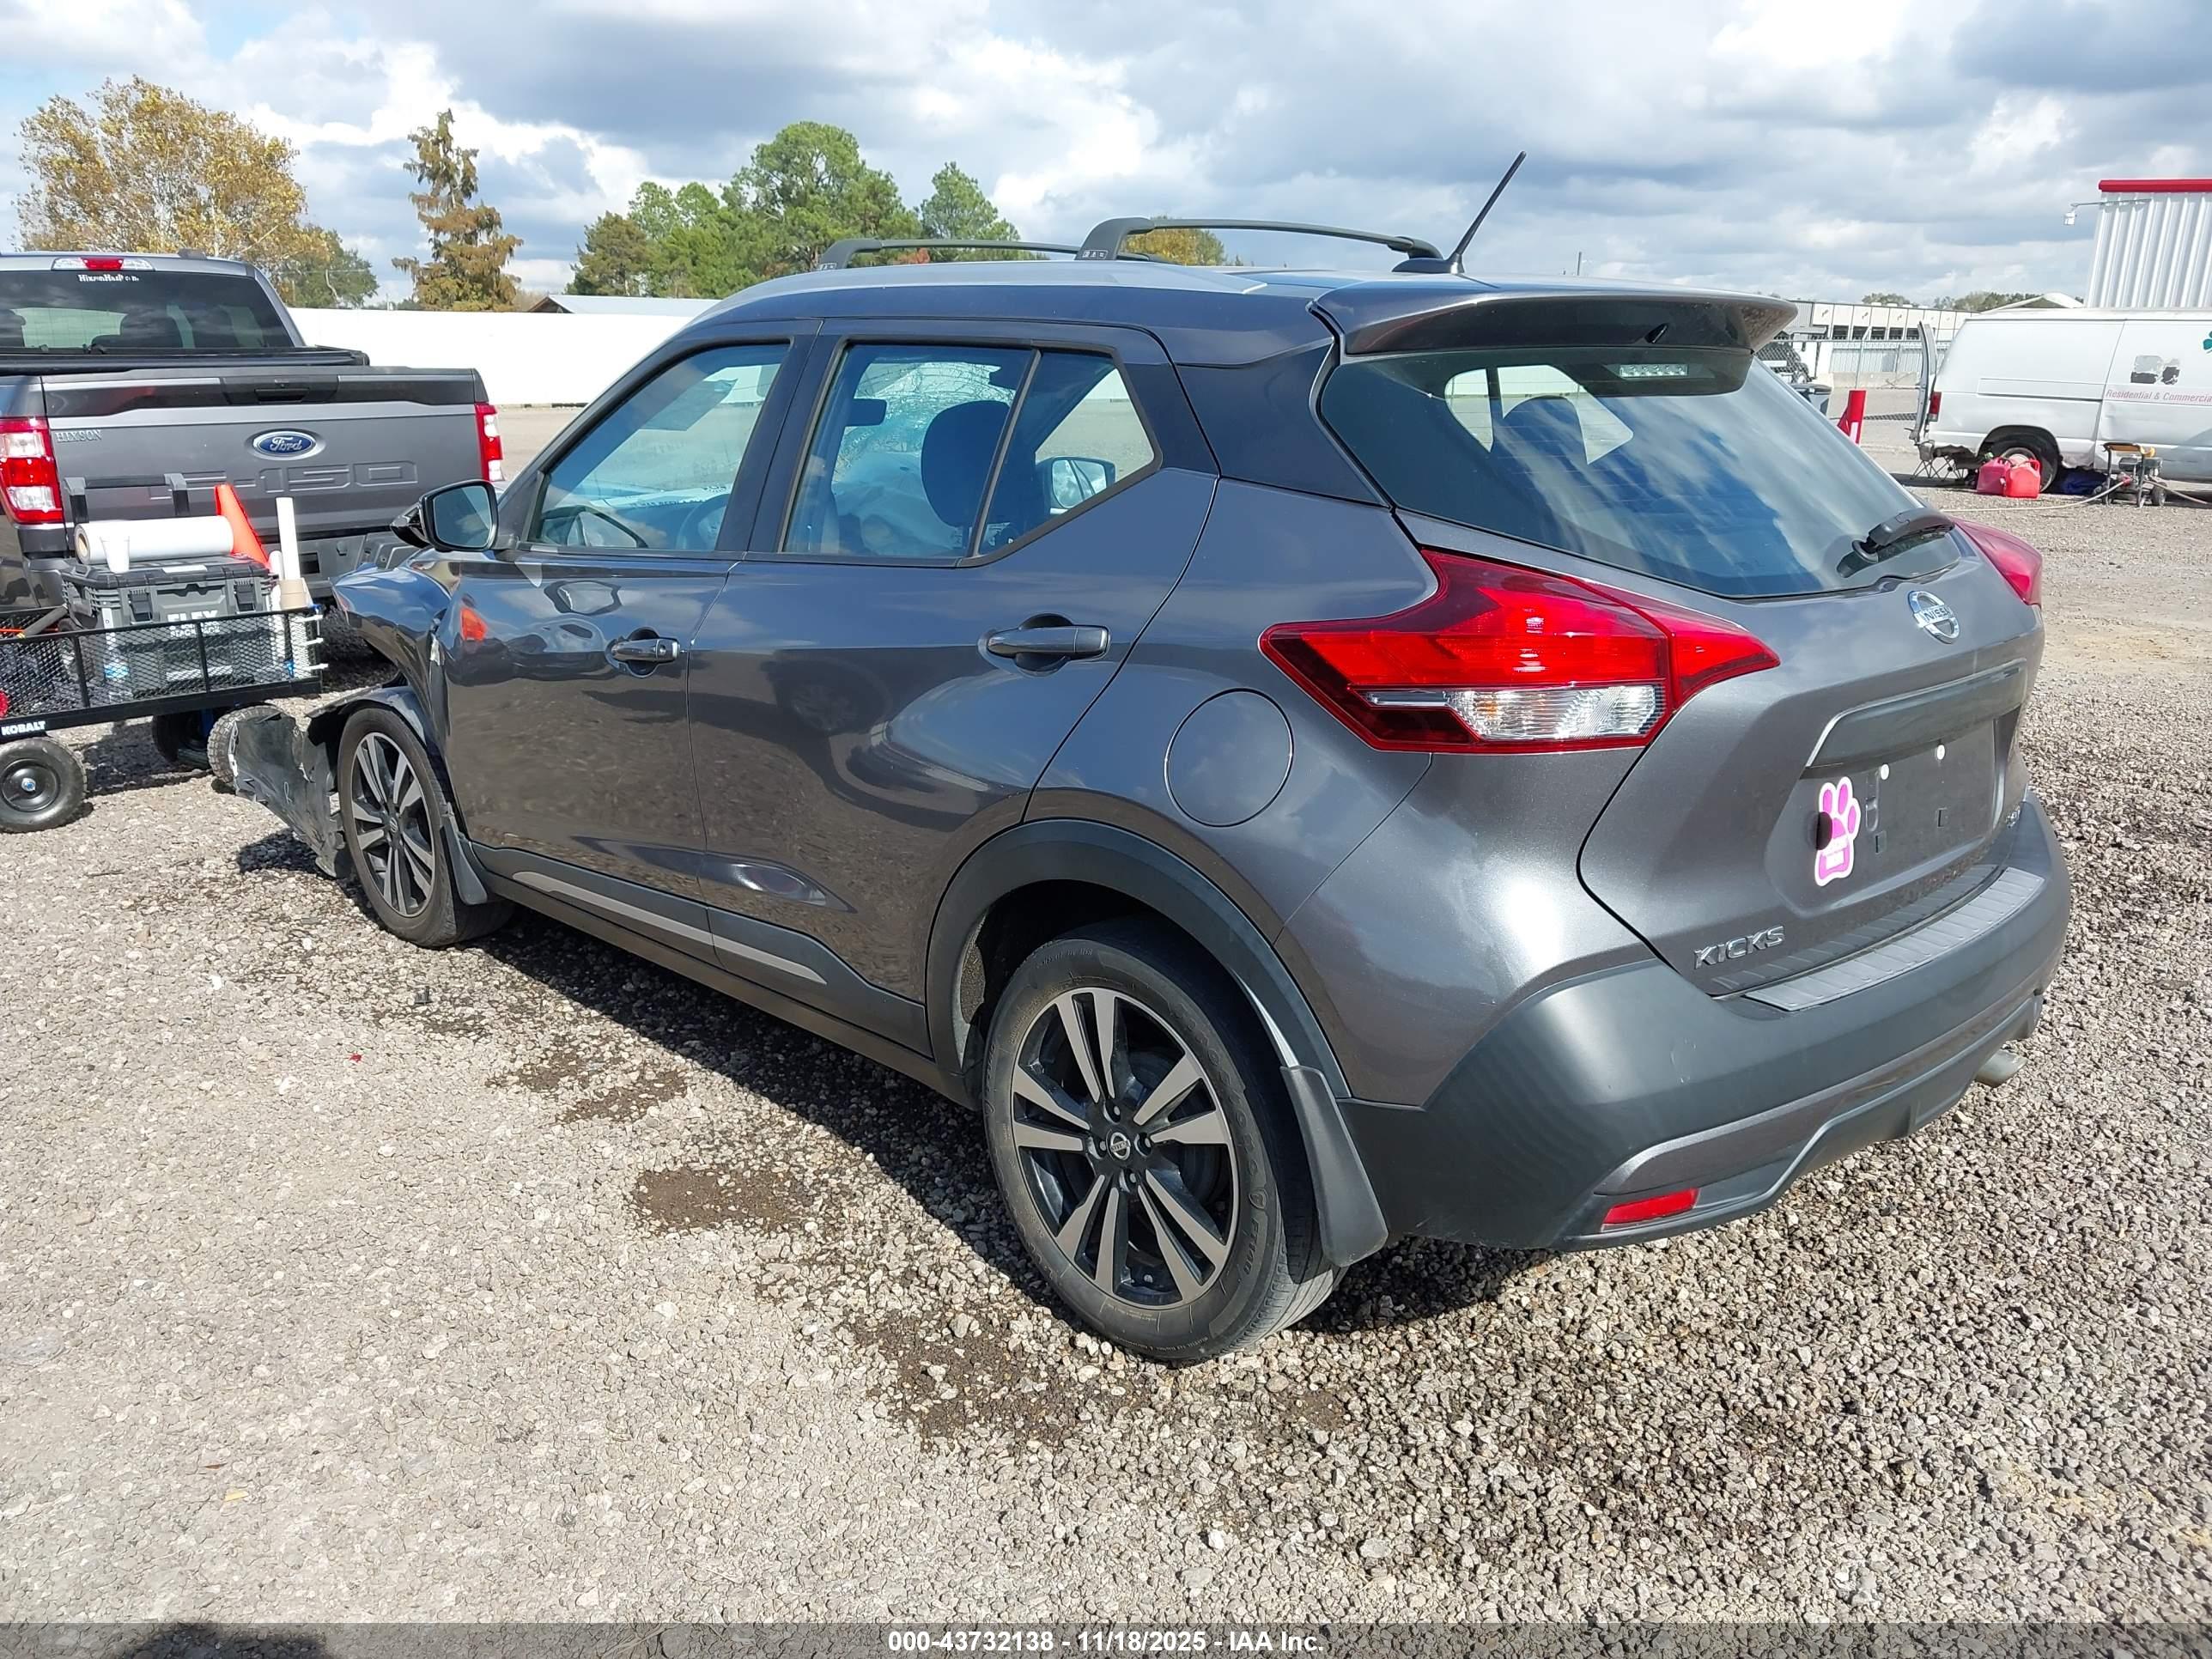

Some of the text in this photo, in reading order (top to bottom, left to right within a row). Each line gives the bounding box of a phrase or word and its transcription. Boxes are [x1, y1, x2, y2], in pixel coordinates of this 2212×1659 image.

[2106, 389, 2212, 404] Residential & Commercia
[55, 428, 101, 442] HIXSON
[270, 436, 303, 451] Ford
[1, 720, 46, 736] KOBALT
[1693, 926, 1784, 969] KICKS
